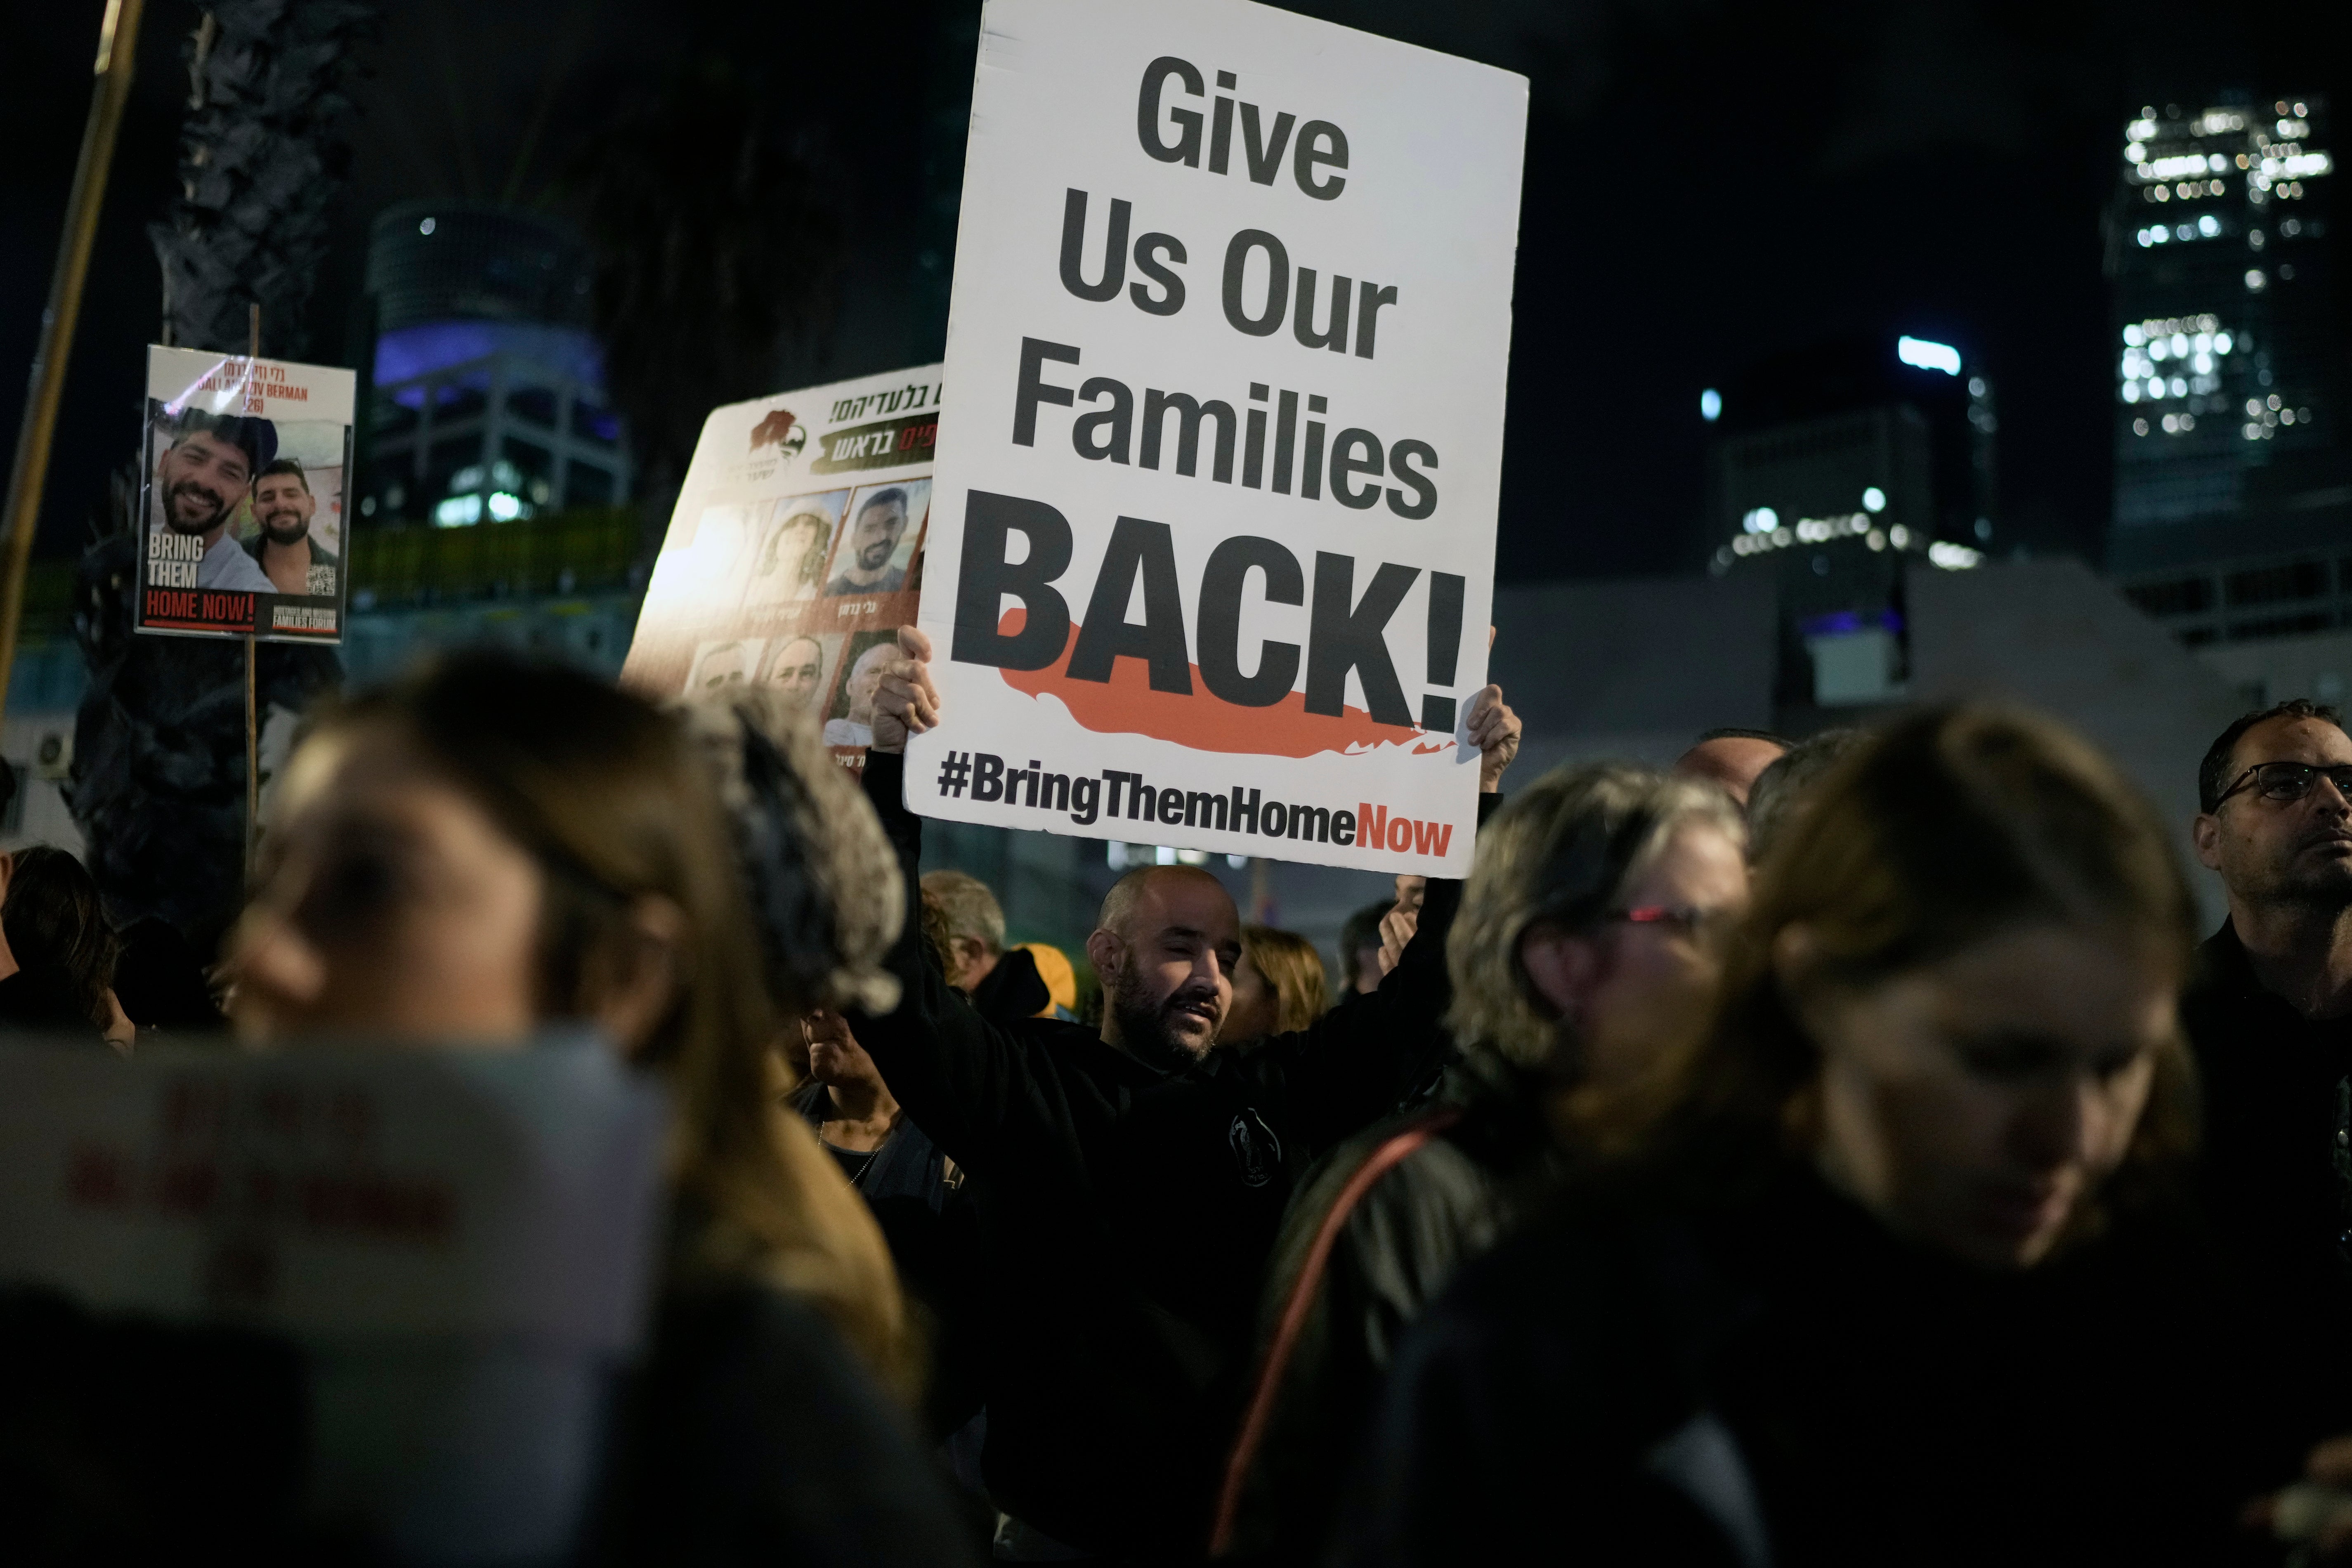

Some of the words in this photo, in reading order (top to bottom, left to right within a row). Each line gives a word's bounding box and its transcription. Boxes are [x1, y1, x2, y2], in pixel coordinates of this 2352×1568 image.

[1138, 57, 1349, 201] Give
[1060, 188, 1187, 316] Us
[1222, 229, 1398, 360] Our
[243, 397, 264, 414] (26)
[267, 383, 308, 402] BERMAN
[828, 385, 929, 424] בלעדיהם!
[831, 430, 895, 462] בראש
[1012, 337, 1438, 520] Families
[149, 532, 204, 562] BRING
[148, 560, 197, 589] THEM
[146, 590, 198, 619] HOME
[202, 593, 254, 622] NOW!
[951, 489, 1466, 734] BACK!
[937, 751, 1453, 857] #BringThemHomeNow
